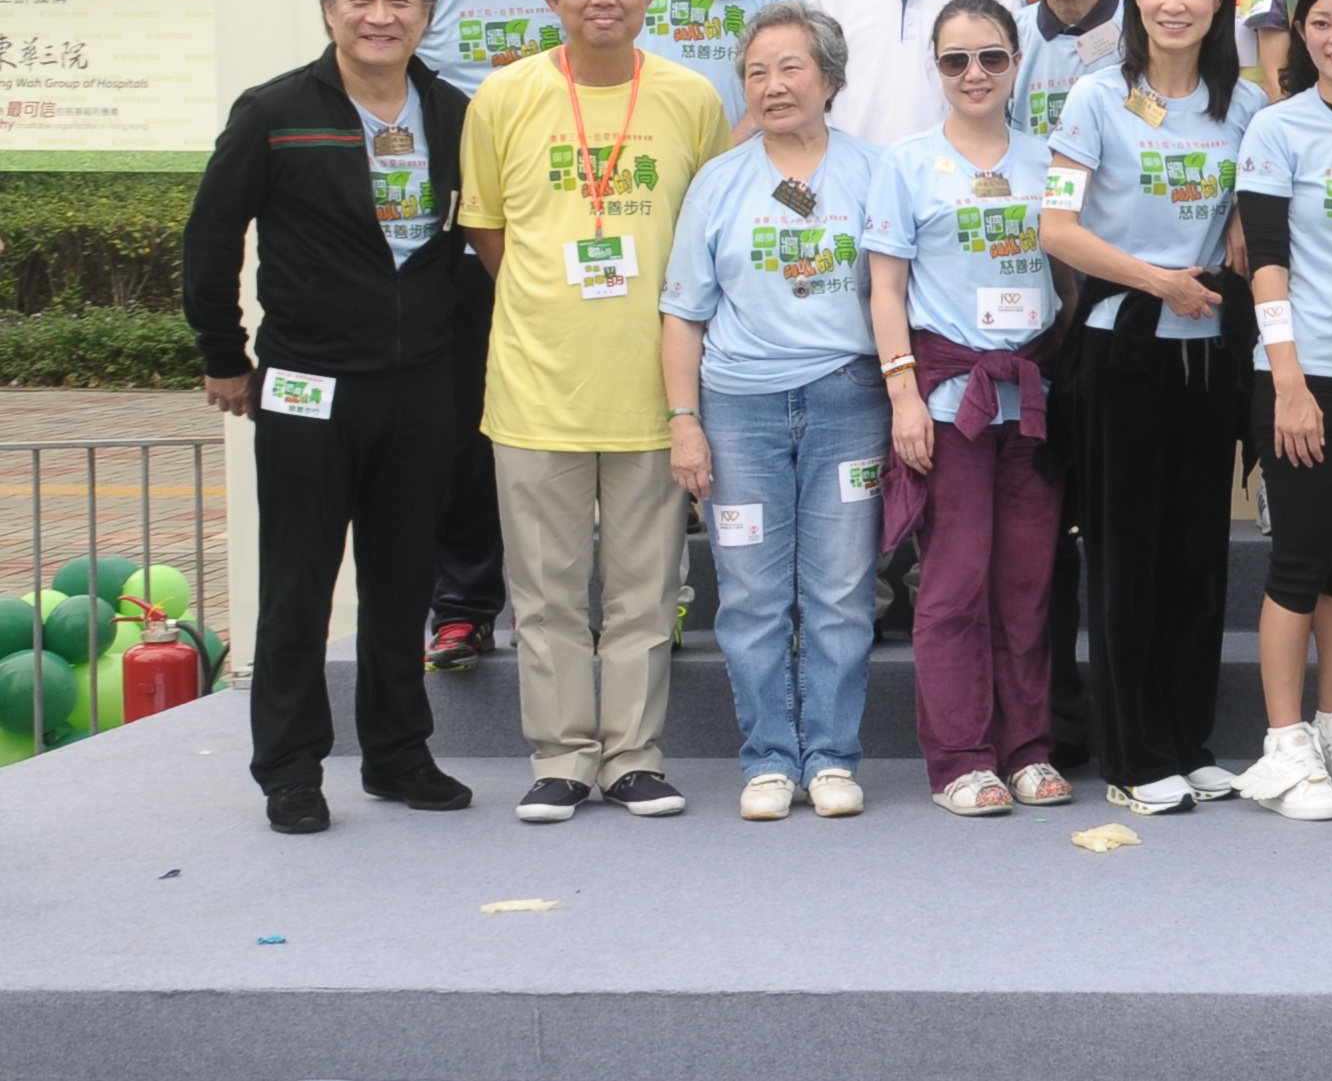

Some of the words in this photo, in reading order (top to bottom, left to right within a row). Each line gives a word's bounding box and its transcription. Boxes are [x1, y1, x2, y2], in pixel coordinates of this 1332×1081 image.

[16, 78, 42, 89] Wah
[44, 78, 81, 91] Group
[83, 78, 96, 89] of
[97, 78, 149, 91] Hospitals
[632, 153, 659, 192] 高
[832, 232, 857, 269] 高
[810, 276, 857, 295] 善步行
